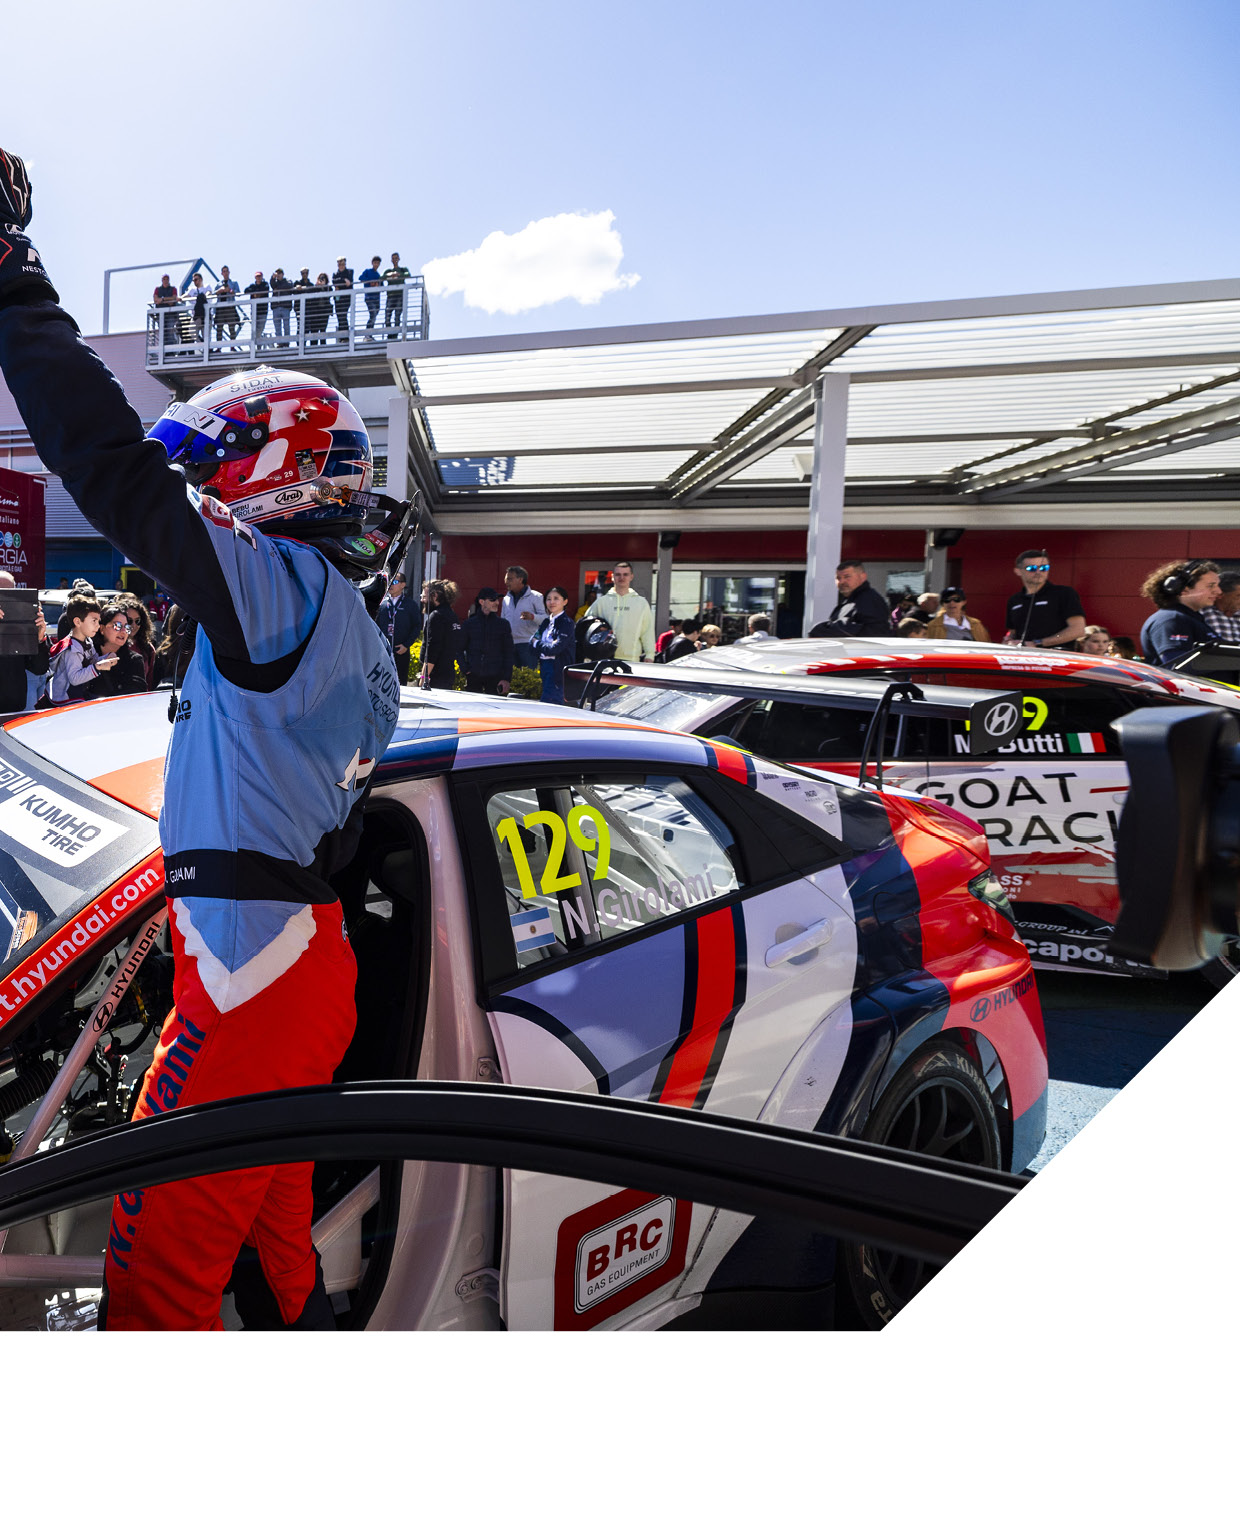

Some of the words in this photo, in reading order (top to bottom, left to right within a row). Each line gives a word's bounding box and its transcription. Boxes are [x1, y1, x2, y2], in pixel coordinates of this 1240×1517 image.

[18, 793, 103, 843] KUMHO
[40, 828, 84, 856] TIRE
[496, 804, 611, 900] 129
[110, 921, 161, 999] HYUNDAI
[993, 971, 1034, 1012] HYUNDAI
[586, 1217, 664, 1283] BRC
[587, 1278, 606, 1296] GAS
[608, 1248, 661, 1284] EQUIPMENT
